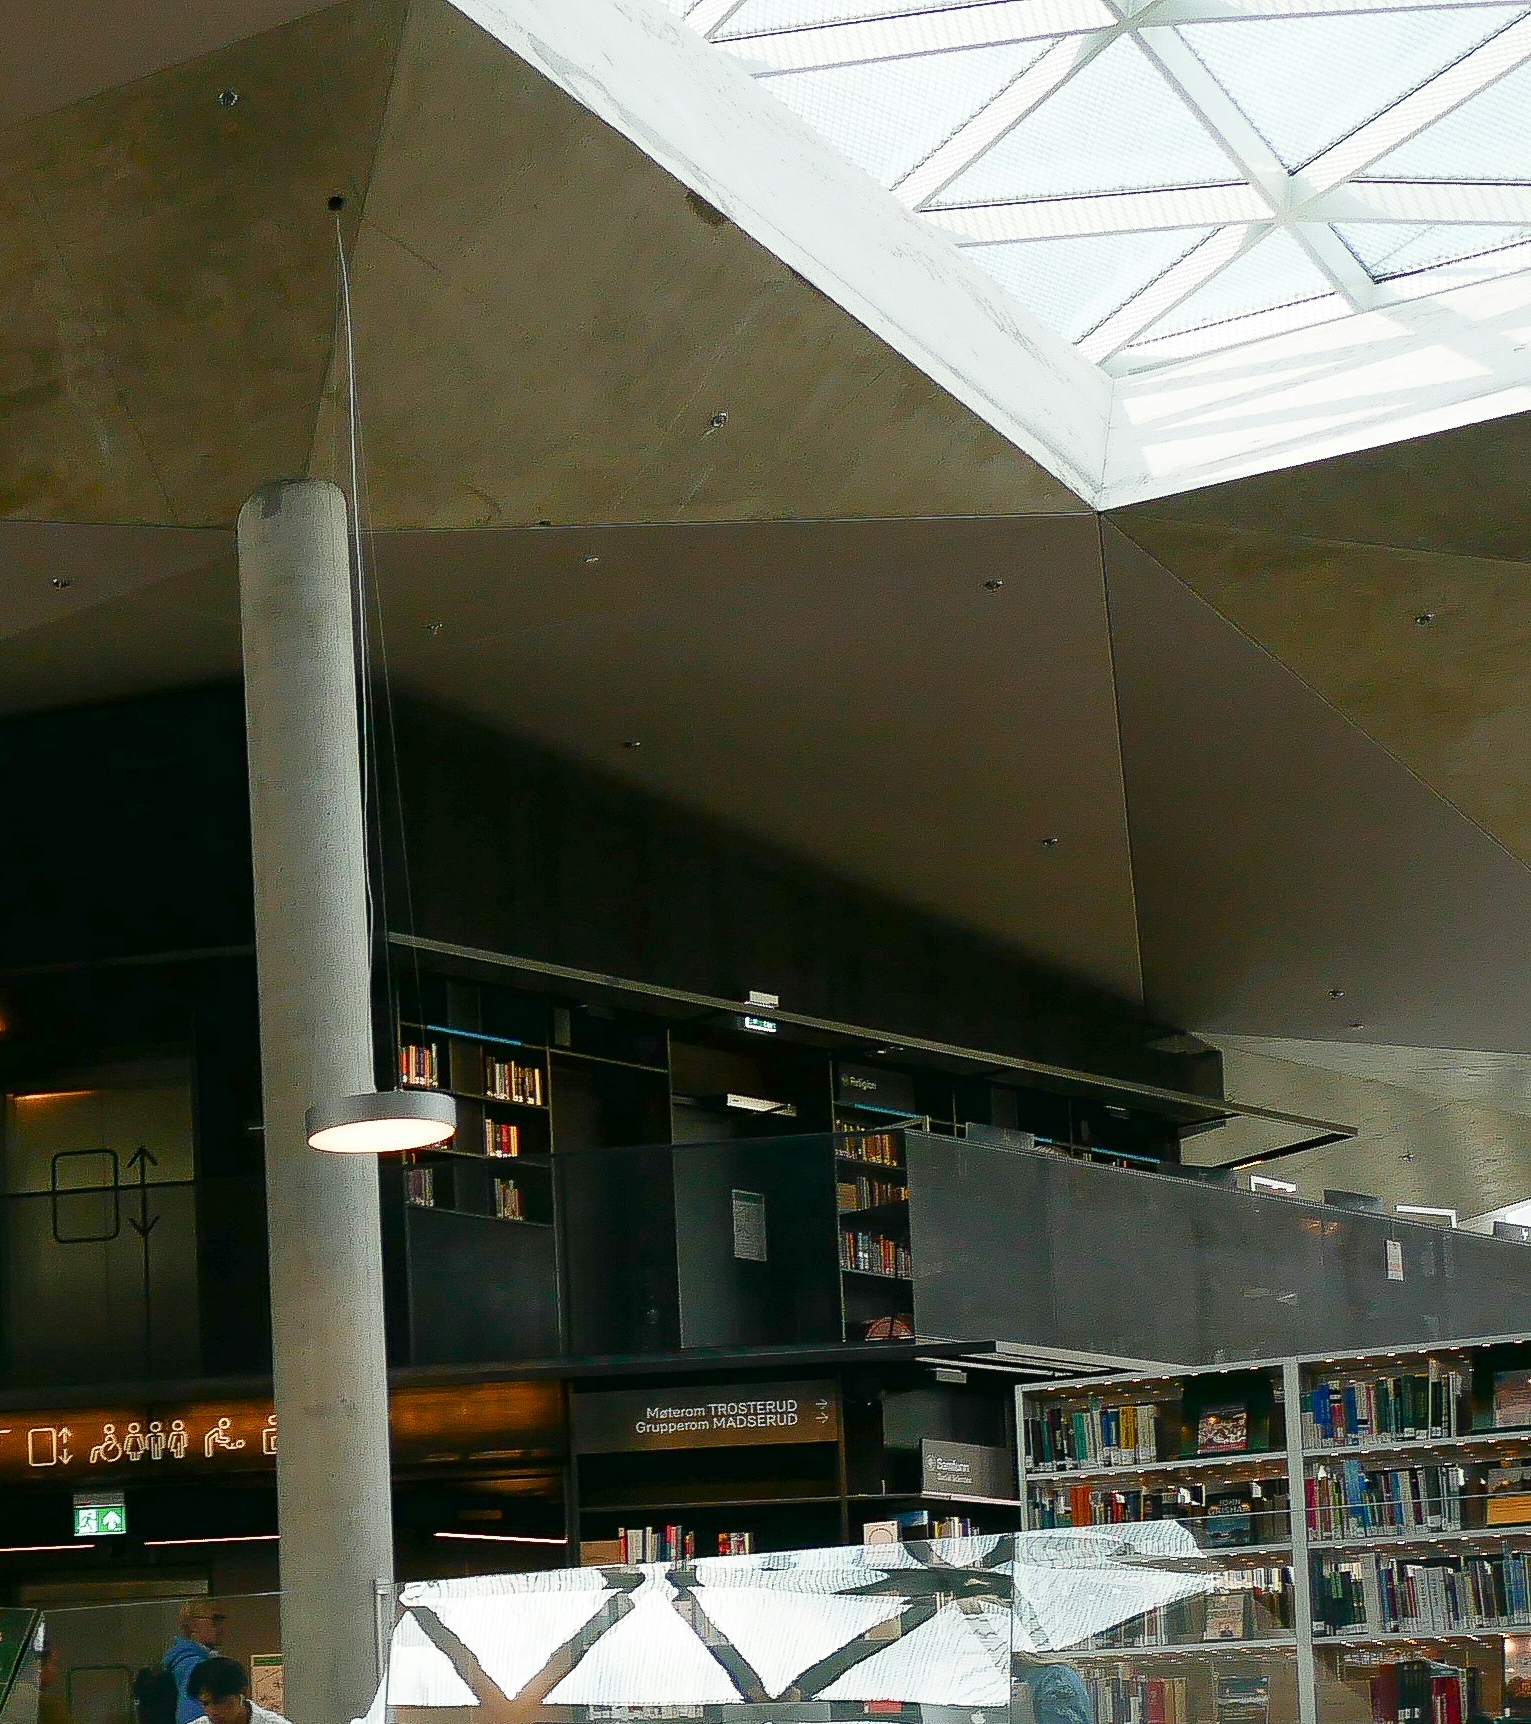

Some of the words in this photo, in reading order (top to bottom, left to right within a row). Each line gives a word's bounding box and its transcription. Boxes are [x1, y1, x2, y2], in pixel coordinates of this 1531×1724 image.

[646, 1406, 706, 1419] Møterom
[708, 1399, 798, 1415] TROSTERUD
[635, 1420, 709, 1435] Grupperom
[712, 1412, 798, 1429] MADSERUD
